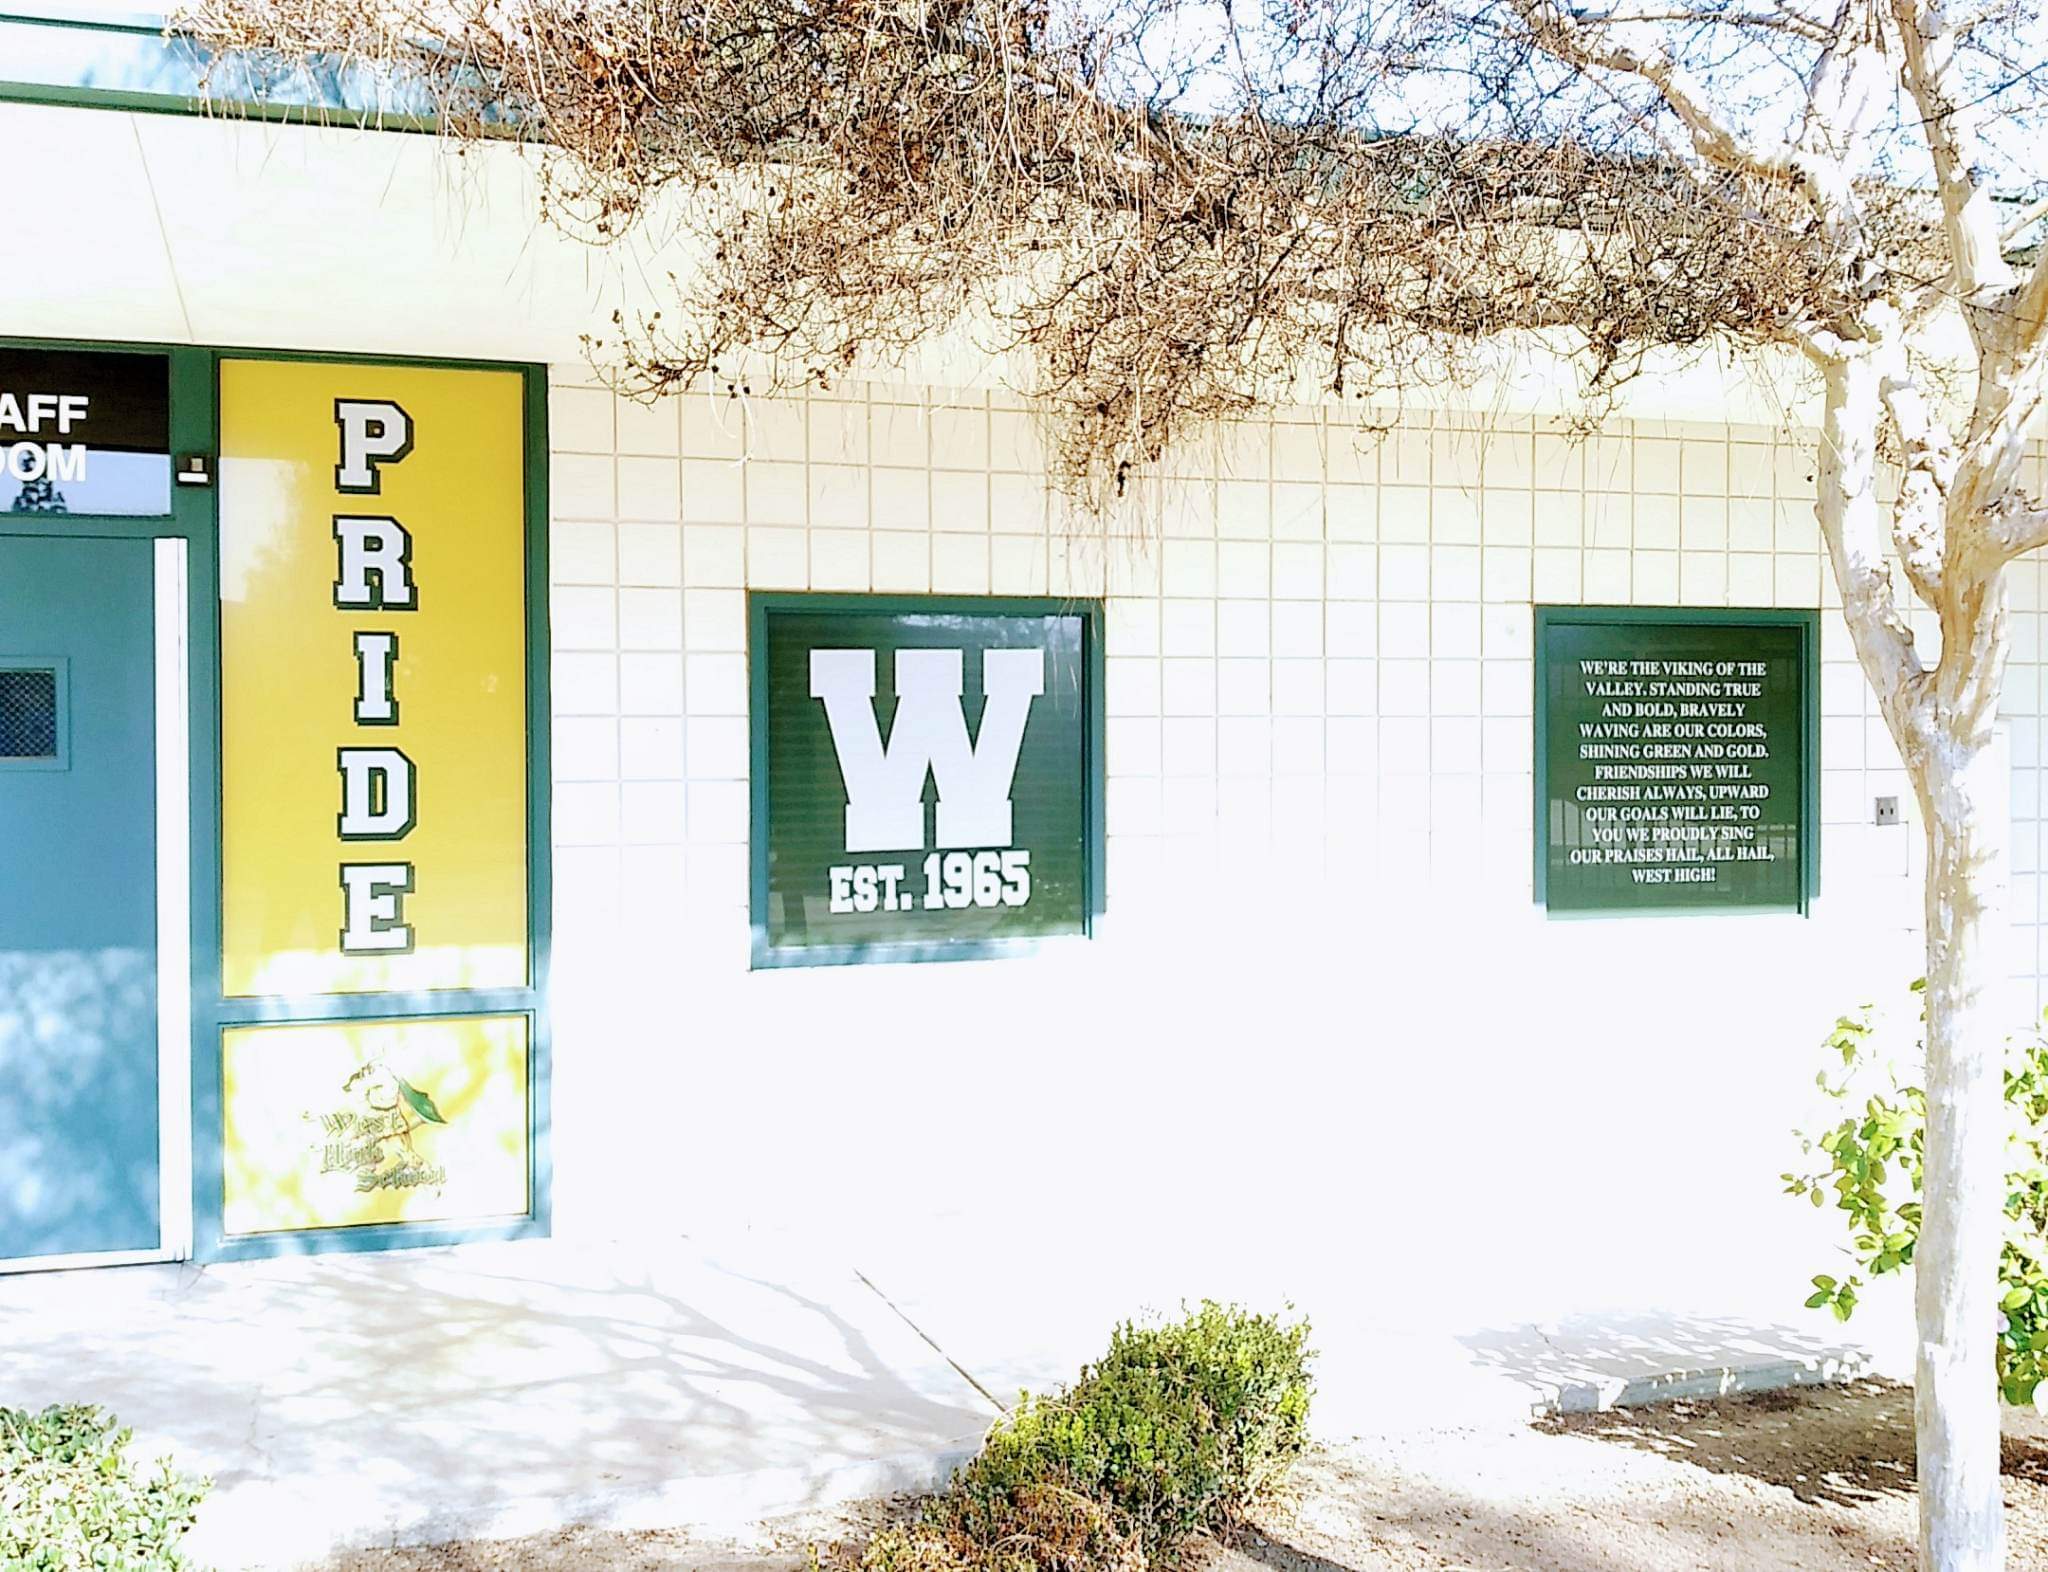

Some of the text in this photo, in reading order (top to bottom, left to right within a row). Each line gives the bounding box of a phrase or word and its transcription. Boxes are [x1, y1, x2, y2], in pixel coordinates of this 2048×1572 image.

[0, 392, 89, 434] AFF
[0, 441, 87, 482] OM
[333, 398, 418, 956] PRIDE
[1580, 660, 1767, 676] WE'RE THE VIKING OF THE
[1649, 681, 1721, 697] STANDING
[1723, 681, 1762, 697] TRUE
[1602, 702, 1746, 720] AND BOLD, BRAVELY
[1579, 723, 1768, 740] WAVING ARE OUR COLORS,
[809, 648, 1045, 852] W
[1580, 743, 1770, 759] SHINING GREEN AND GOLD.
[1595, 764, 1752, 780] FRIENDSHIPS WE WILL
[1576, 784, 1770, 801] CHERISH ALWAYS, UPWARD
[1585, 804, 1761, 822] OUR GOALS WILL LIE, TO
[1592, 825, 1755, 843] YOU WE PROUDLY SING
[1570, 845, 1775, 865] OUR PRAISES HAIL, ALL HAIL,
[828, 850, 1031, 914] EST. 1965
[1632, 866, 1717, 884] WEST HIGH!
